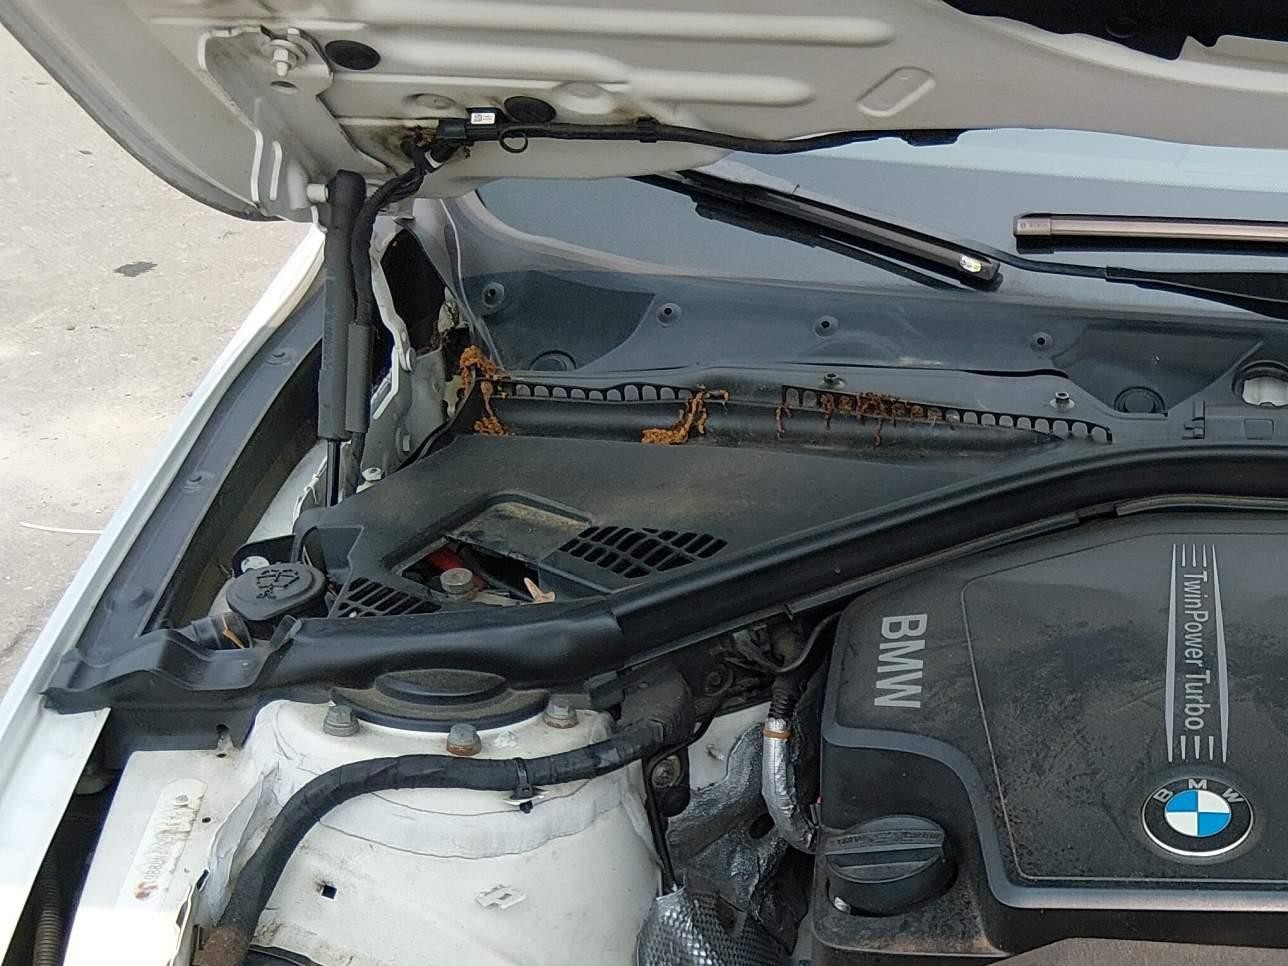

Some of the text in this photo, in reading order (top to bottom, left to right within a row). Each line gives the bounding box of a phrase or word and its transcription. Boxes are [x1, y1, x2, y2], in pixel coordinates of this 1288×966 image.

[874, 613, 928, 709] BMW
[1183, 570, 1212, 731] TwinPower Turbo
[1153, 778, 1244, 803] BMW
